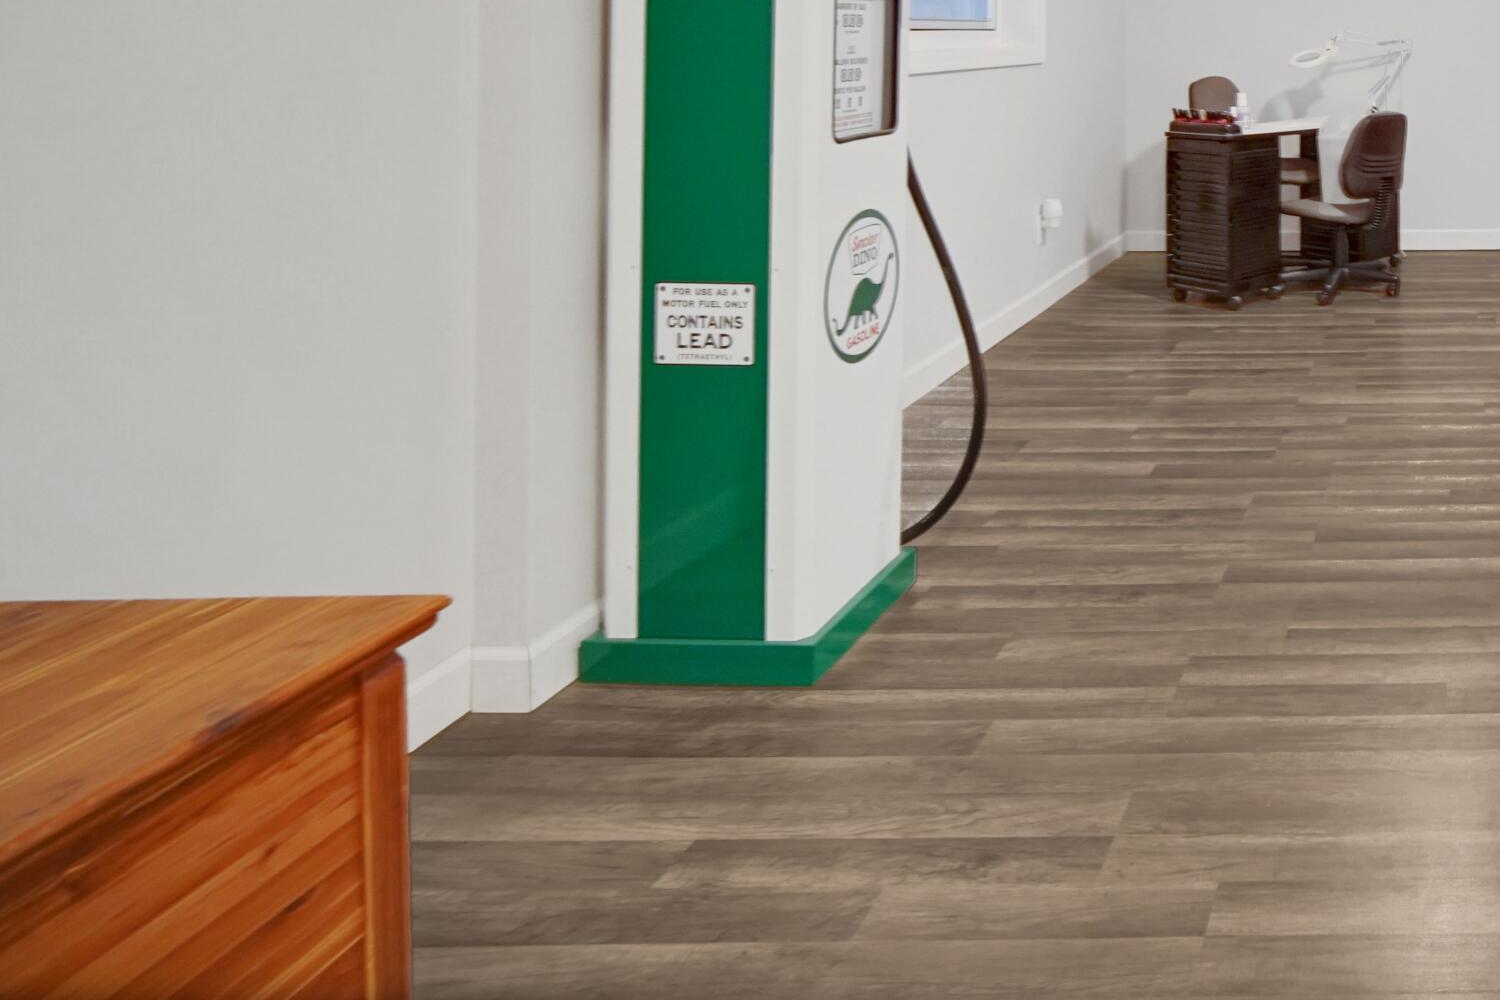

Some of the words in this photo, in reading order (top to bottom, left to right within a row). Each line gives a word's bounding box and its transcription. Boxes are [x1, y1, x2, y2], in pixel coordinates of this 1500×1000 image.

[672, 287, 691, 296] FOR
[694, 288, 713, 296] USE
[717, 288, 729, 296] AS
[662, 300, 696, 308] MOTOR
[698, 300, 721, 308] FUEL
[724, 301, 749, 309] ONLY
[666, 314, 744, 330] CONTAINS
[676, 332, 734, 350] LEAD
[846, 322, 880, 349] GASOLINE
